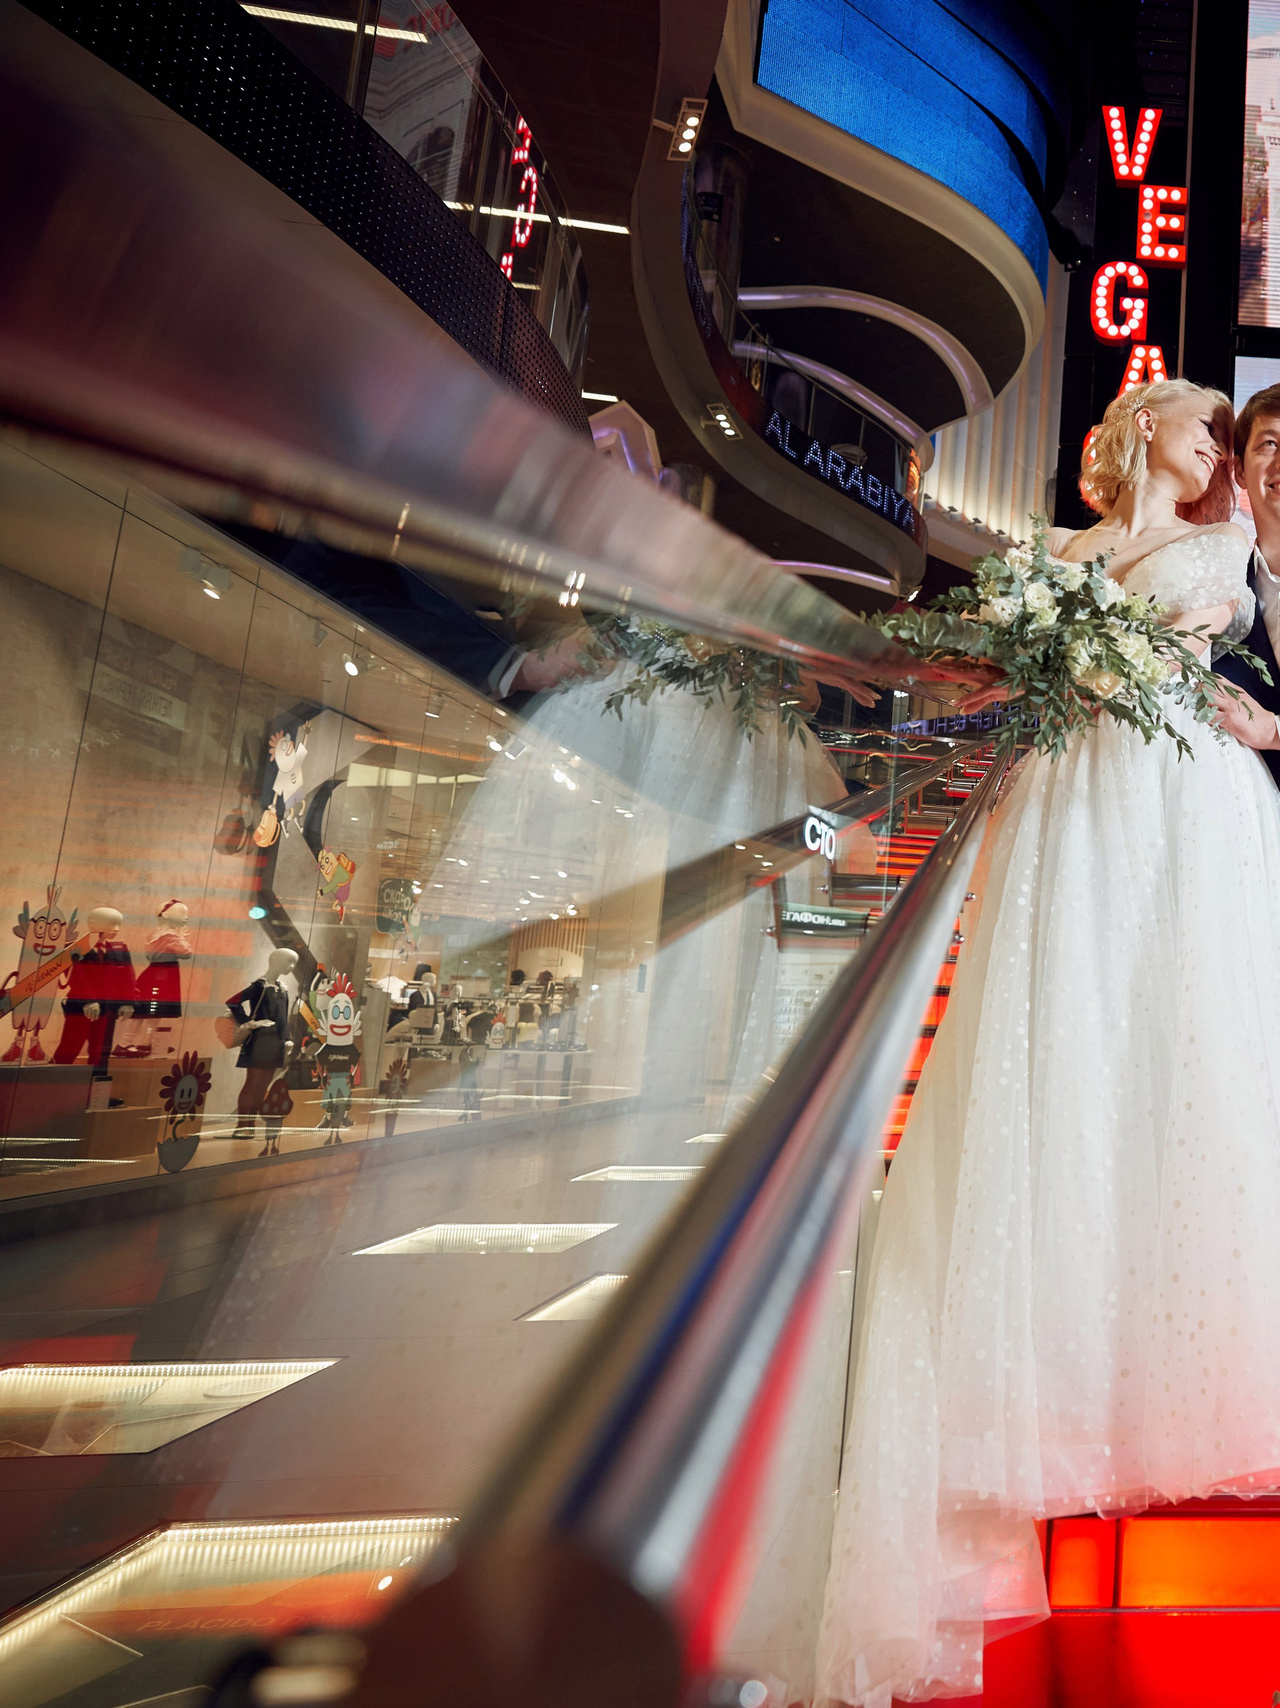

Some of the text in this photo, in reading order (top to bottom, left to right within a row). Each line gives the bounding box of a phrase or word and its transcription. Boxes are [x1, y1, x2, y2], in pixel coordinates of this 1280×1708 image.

[1083, 106, 1188, 510] VEGA
[765, 410, 915, 532] AL ARABIYA
